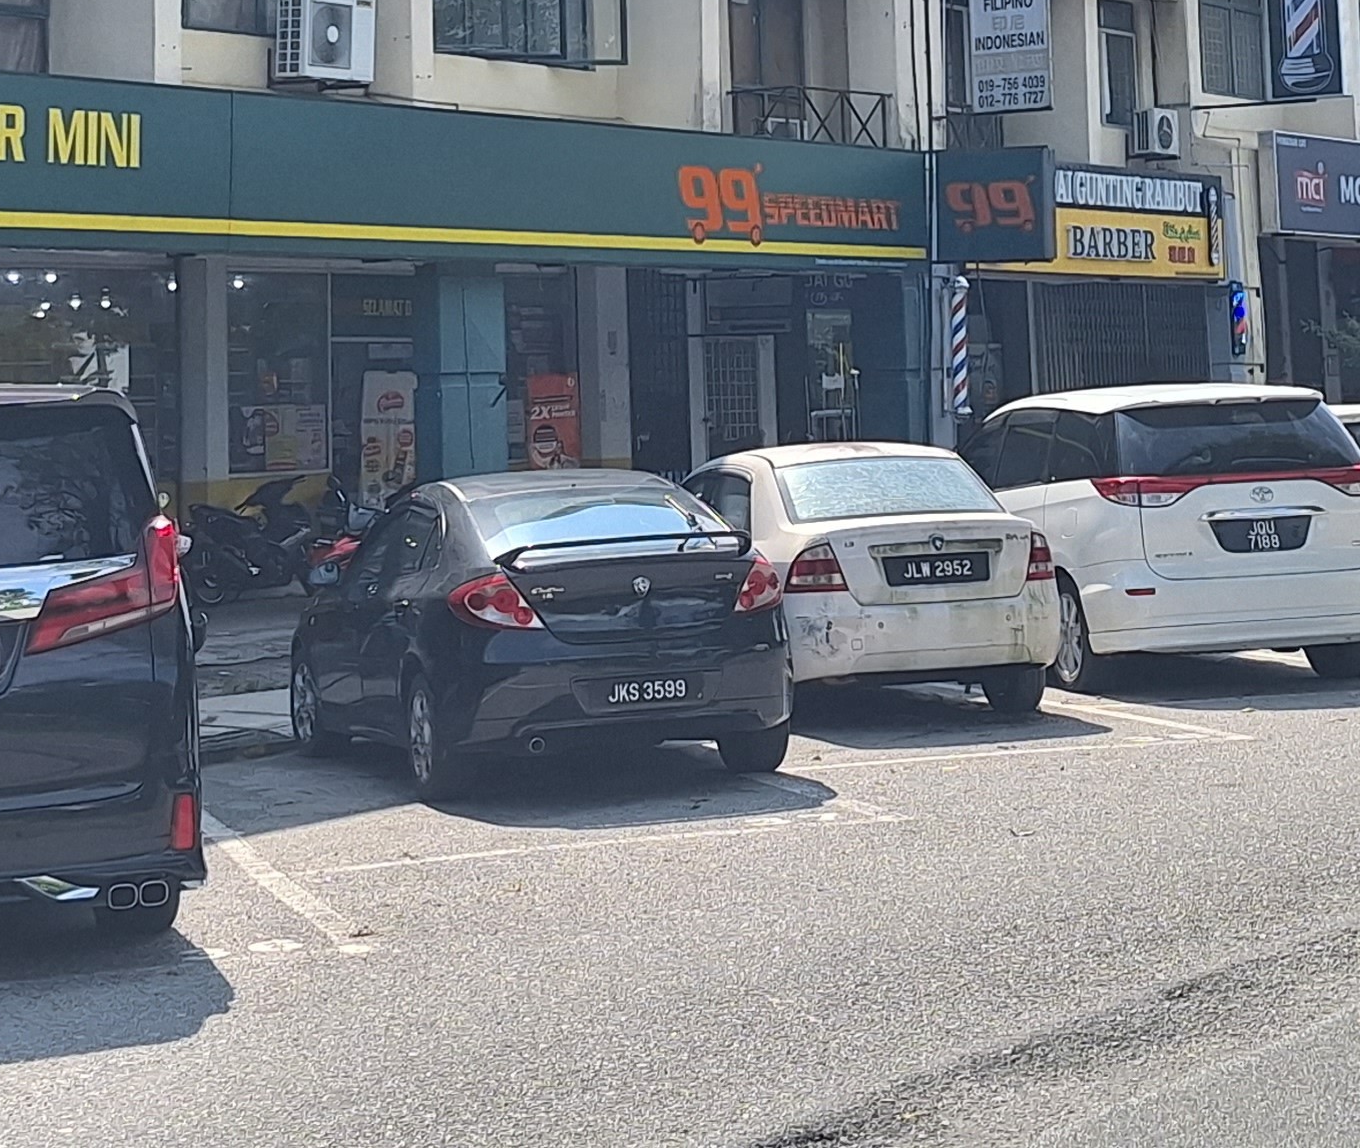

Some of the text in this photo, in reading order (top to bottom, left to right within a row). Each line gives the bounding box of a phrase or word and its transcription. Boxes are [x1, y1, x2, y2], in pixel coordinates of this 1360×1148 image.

[975, 31, 1045, 51] INDONESIAN
[978, 91, 1045, 108] 012-776 1727
[46, 107, 142, 169] MINI
[678, 164, 902, 240] 99 SPEEDMART
[1075, 171, 1142, 210] GUNTING
[1143, 178, 1203, 213] RAMBUT
[946, 180, 1036, 233] 99
[1068, 225, 1157, 262] BARBER
[530, 405, 550, 421] 2X
[1247, 534, 1280, 550] 7188
[903, 559, 973, 579] JLW 2952
[607, 678, 687, 704] JKS 3599
